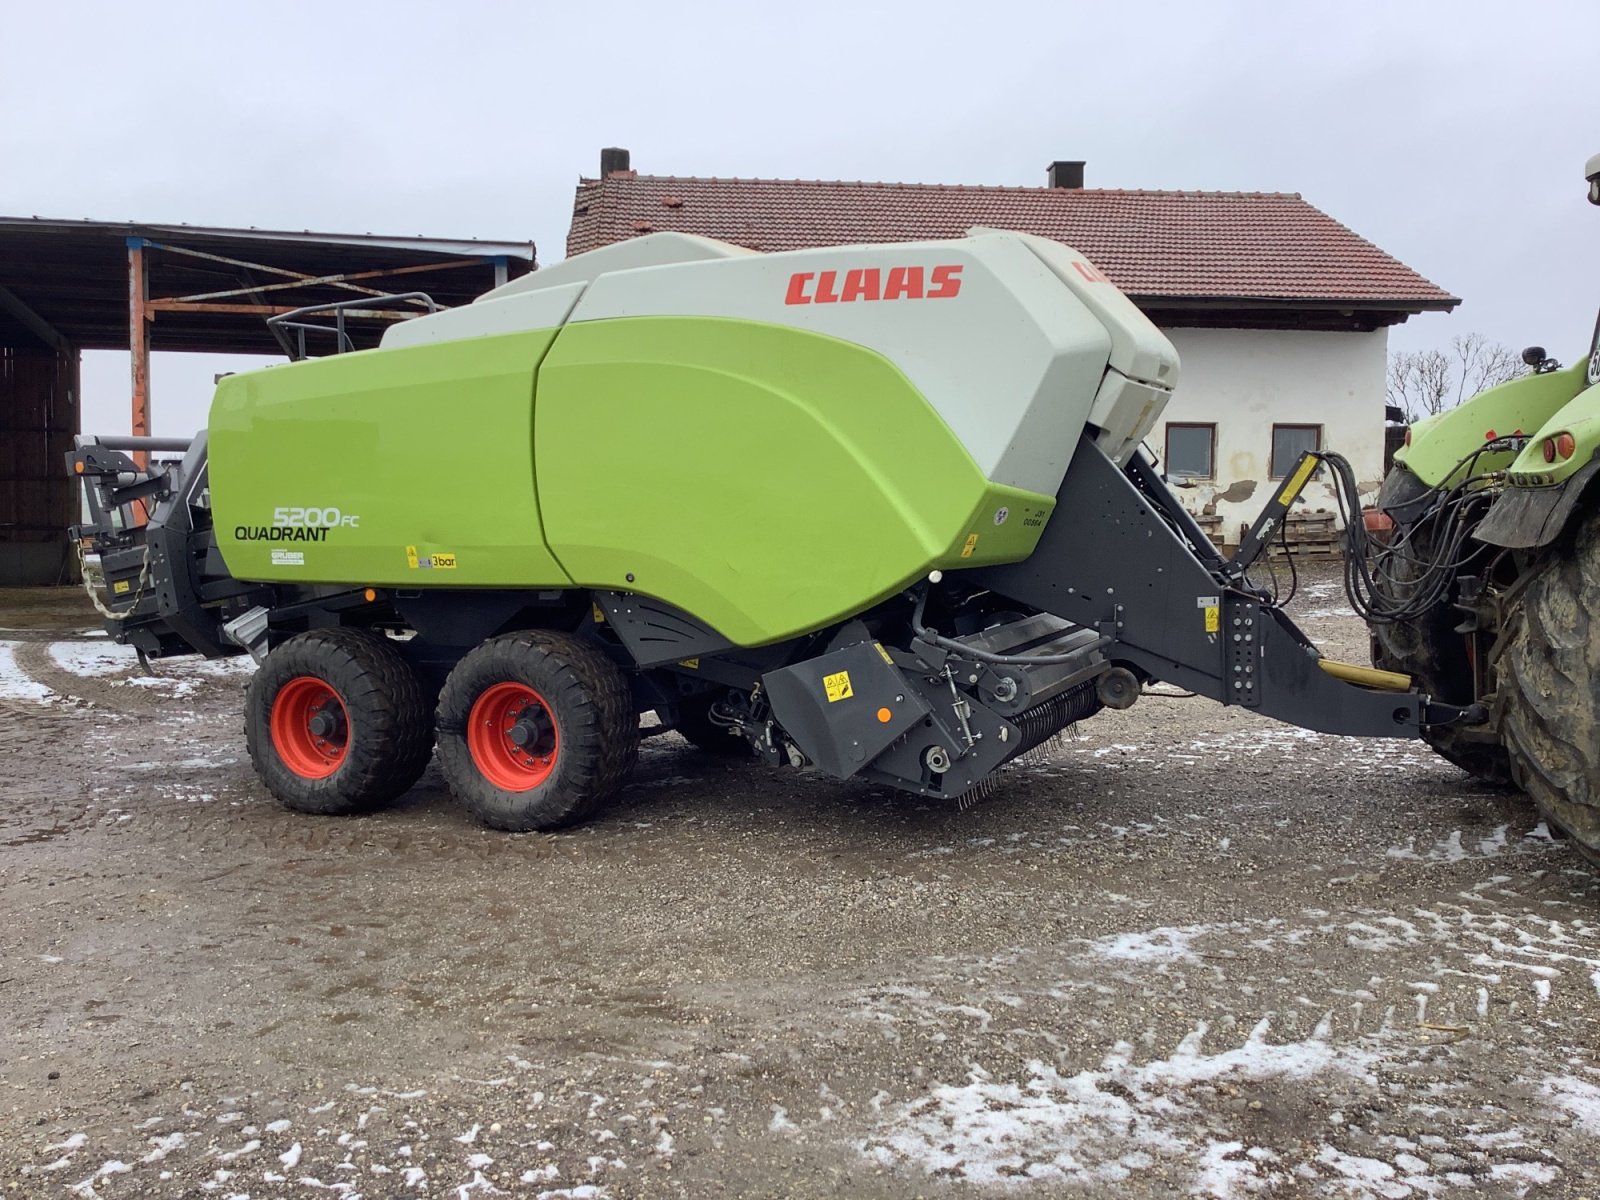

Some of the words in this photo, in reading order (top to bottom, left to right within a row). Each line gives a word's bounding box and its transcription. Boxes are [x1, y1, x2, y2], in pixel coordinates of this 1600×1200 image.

[785, 265, 964, 305] CLAAS
[273, 507, 341, 527] 5200
[341, 515, 360, 527] FC
[235, 526, 330, 541] QUADRANT
